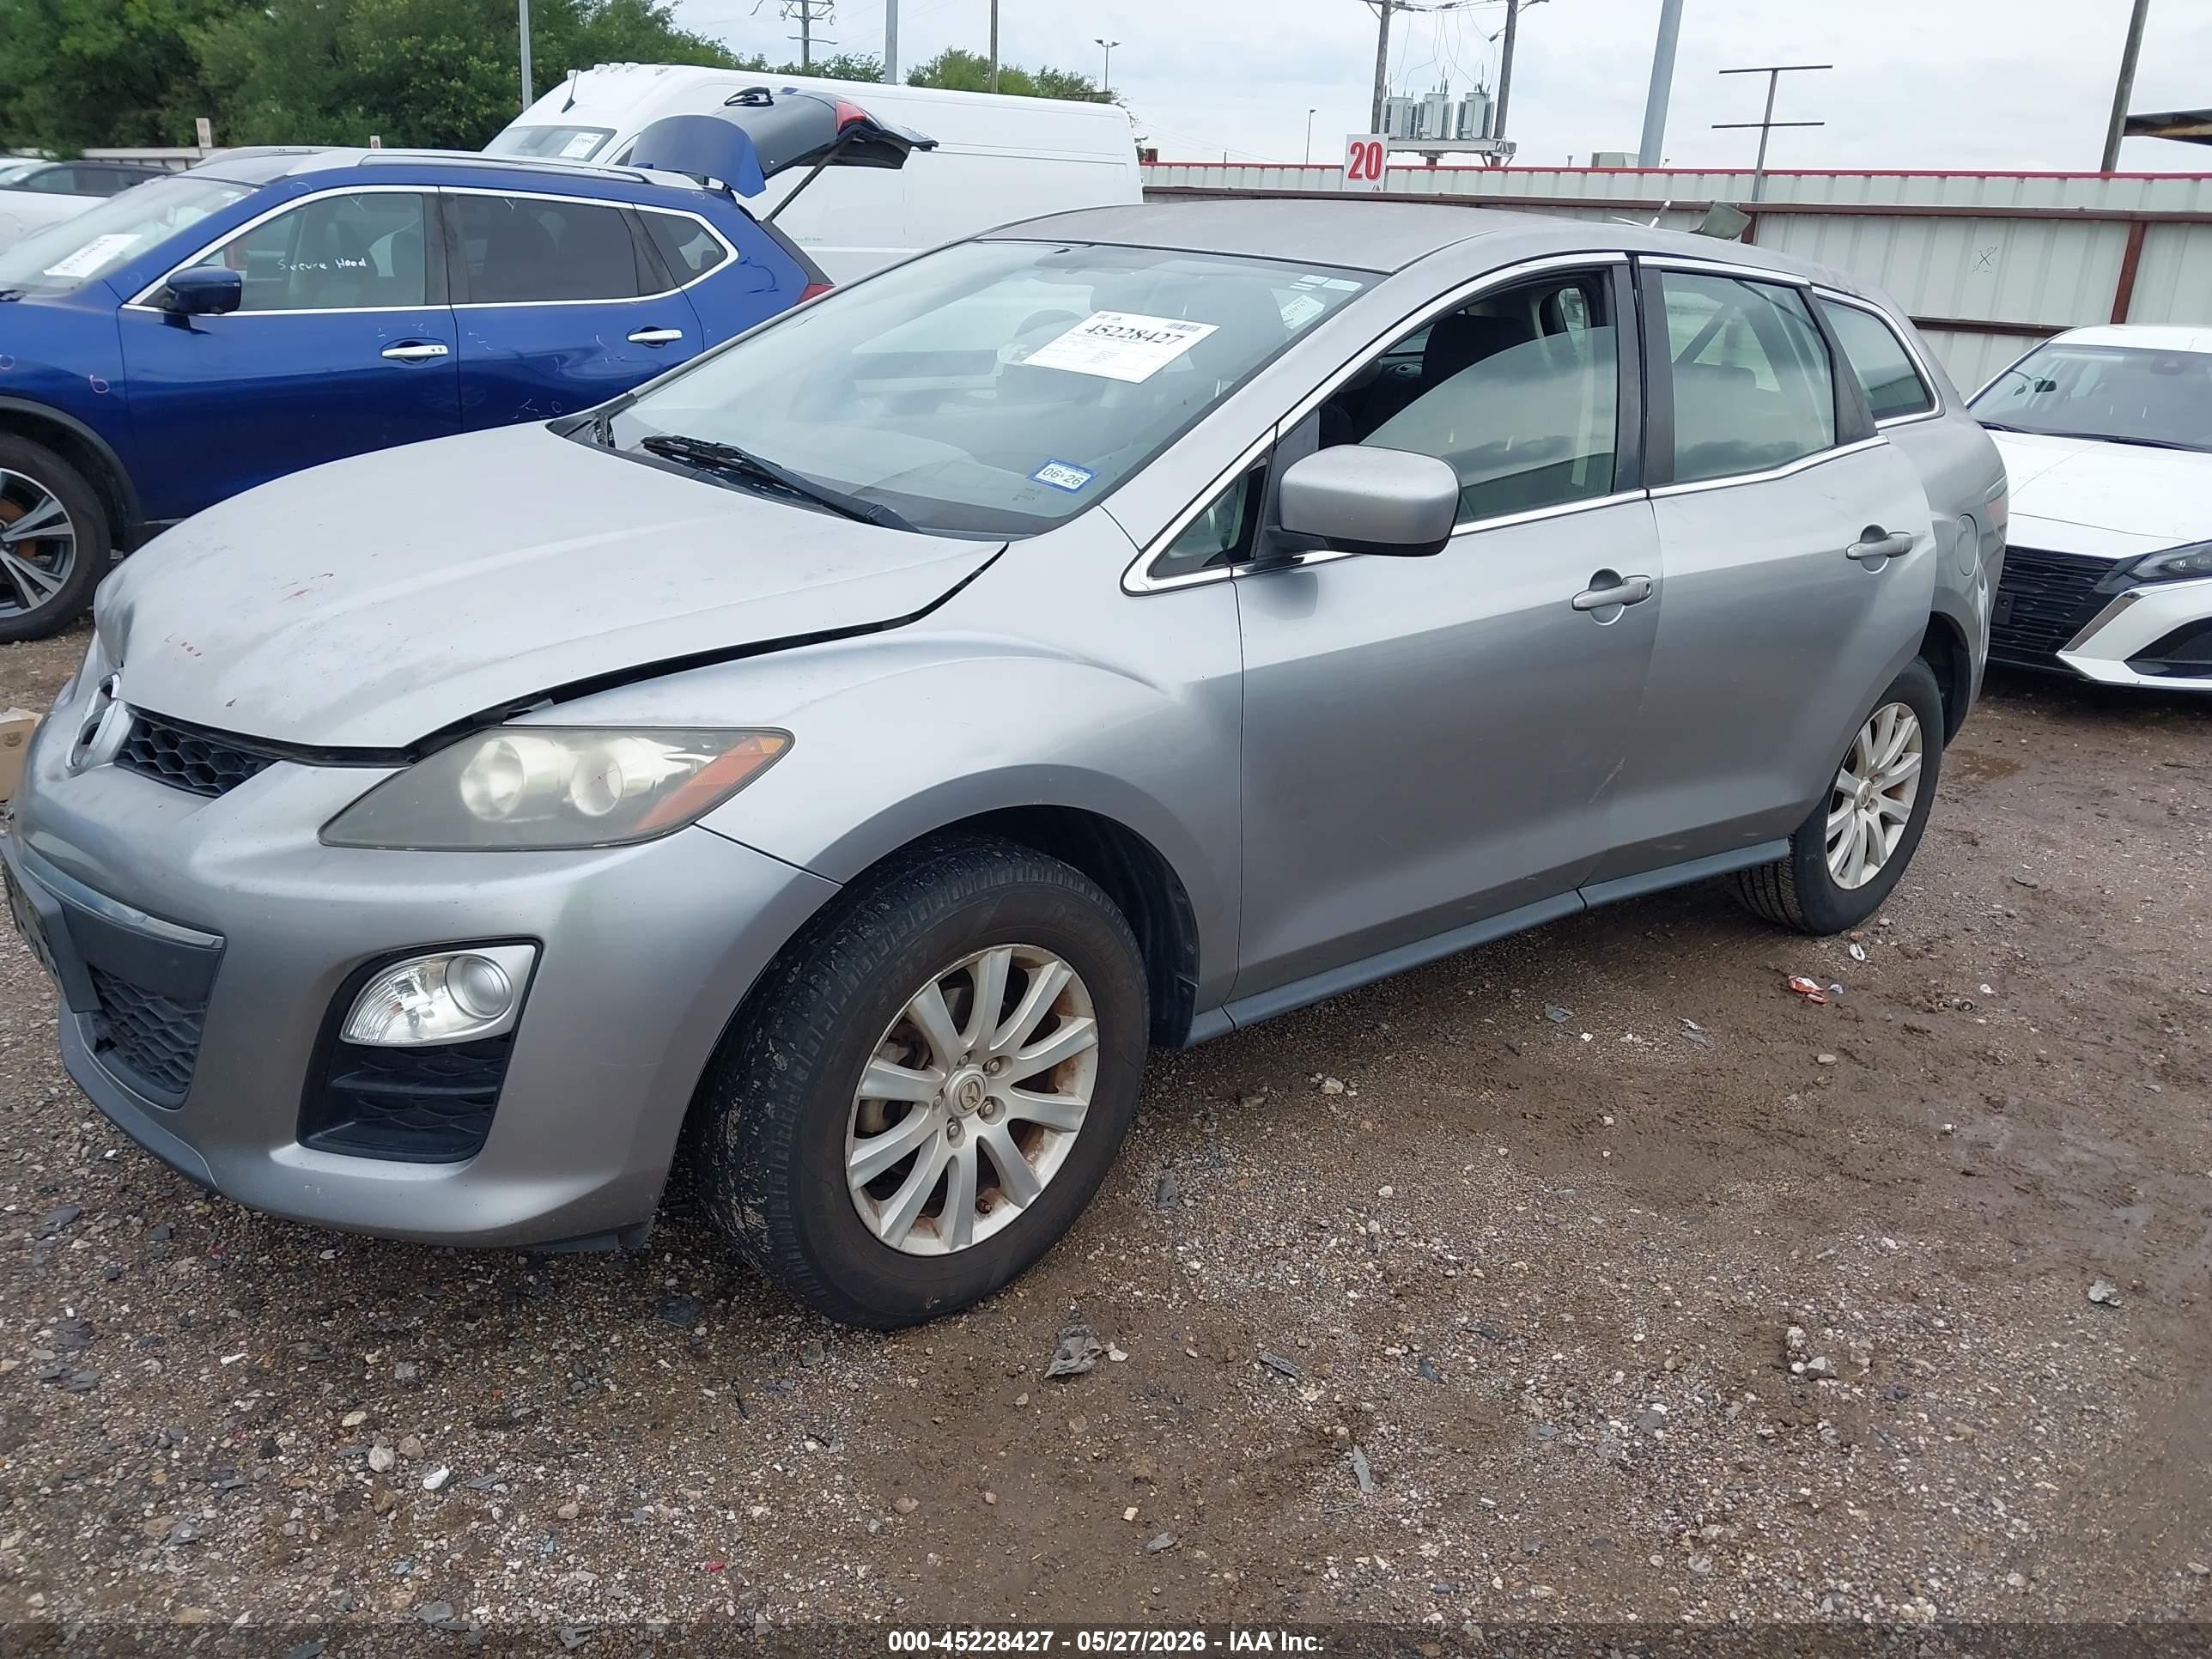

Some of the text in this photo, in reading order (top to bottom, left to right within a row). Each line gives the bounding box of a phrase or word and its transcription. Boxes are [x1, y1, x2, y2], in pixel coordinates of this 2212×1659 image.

[1347, 141, 1382, 180] 20
[335, 258, 367, 268] Hood
[1085, 324, 1185, 345] 45228427
[1042, 468, 1084, 485] 06 26
